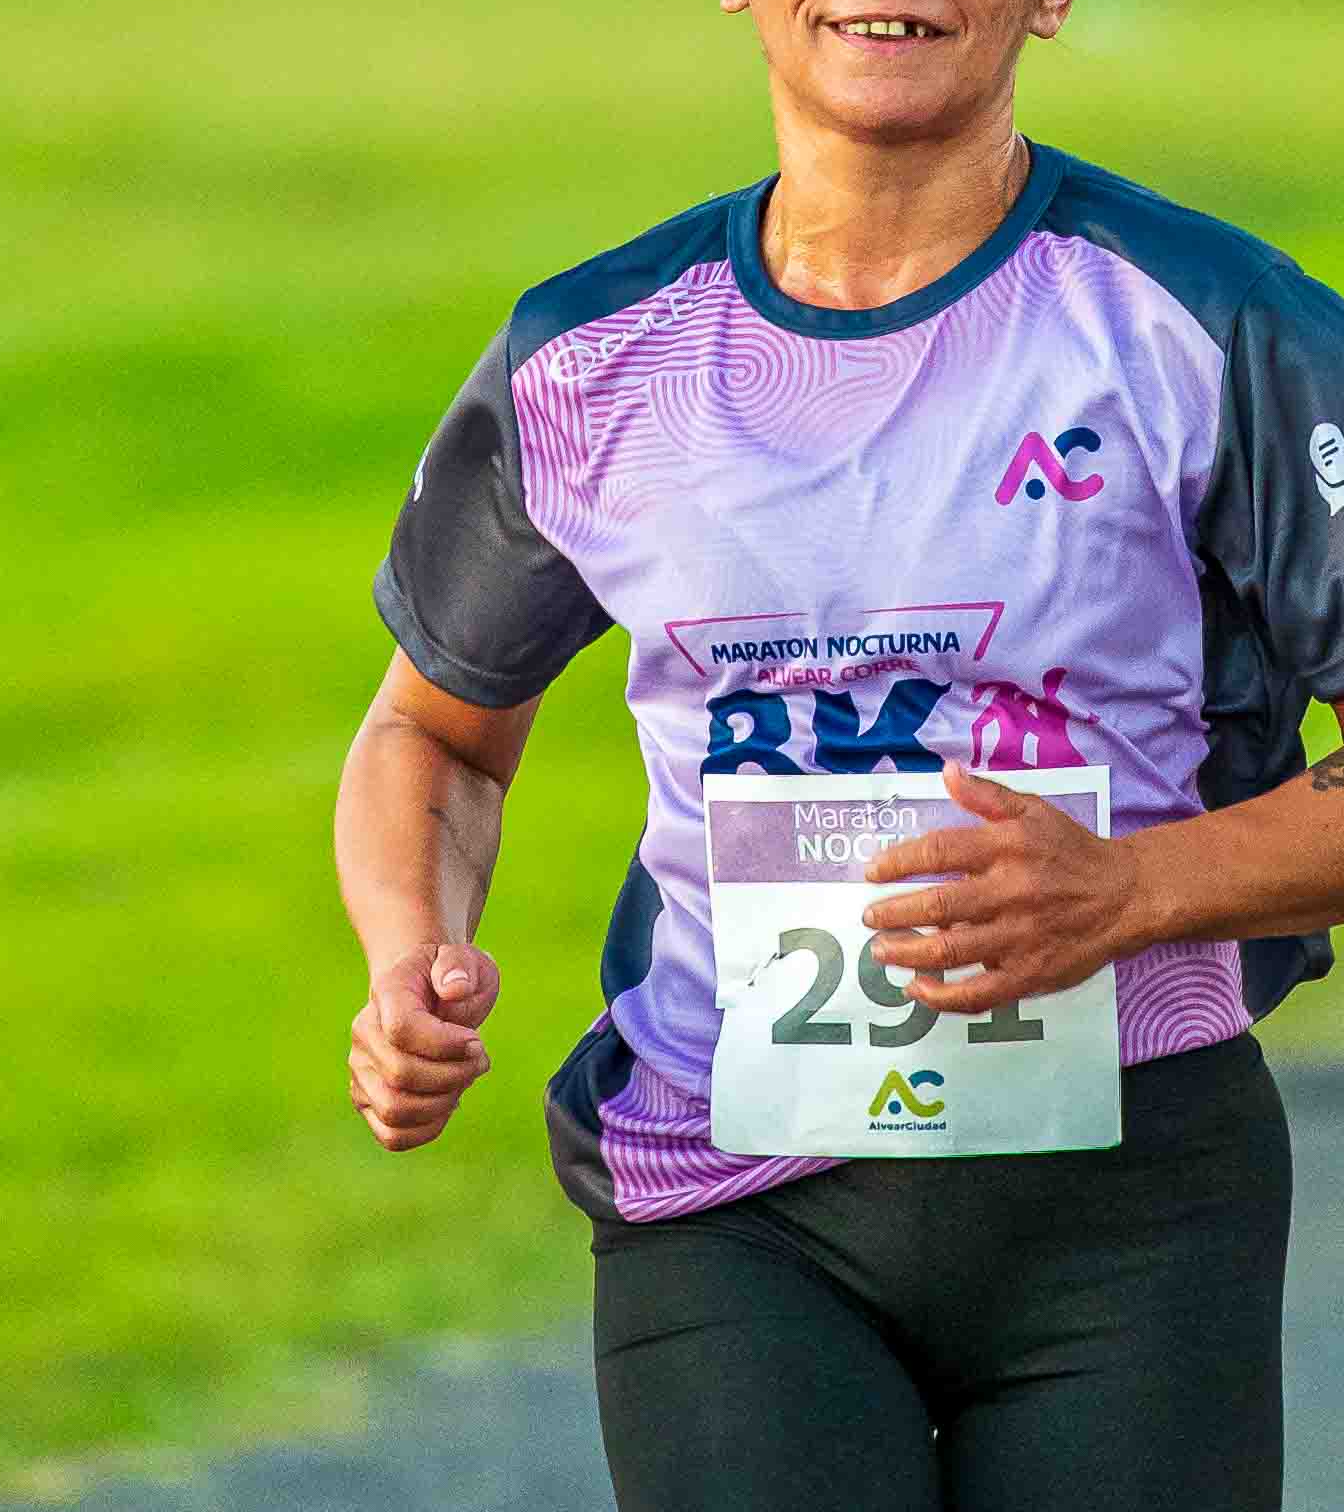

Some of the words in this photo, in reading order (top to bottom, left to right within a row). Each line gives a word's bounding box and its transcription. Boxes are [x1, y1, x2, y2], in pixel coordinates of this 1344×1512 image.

[710, 637, 818, 664] MARATON
[827, 631, 961, 659] NOCTURNA
[757, 664, 835, 687] ALVEAR
[797, 832, 904, 863] NOCT
[868, 1120, 947, 1132] AlvearCiudad
